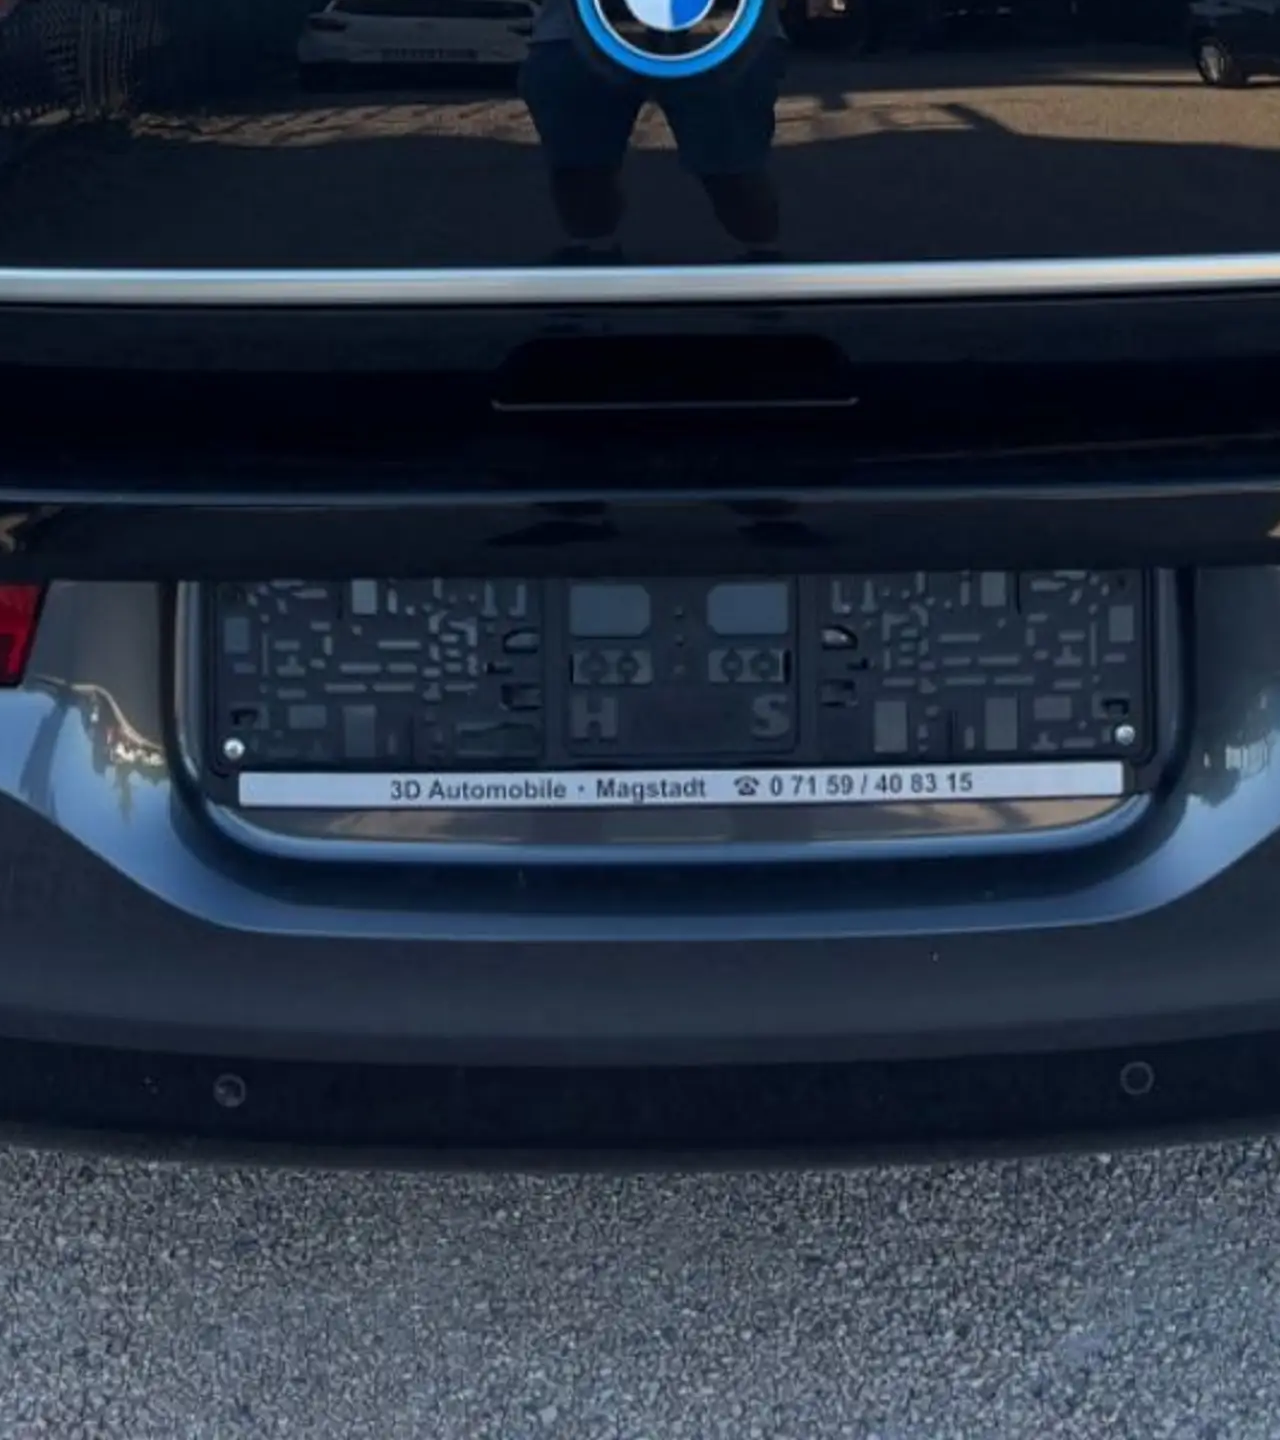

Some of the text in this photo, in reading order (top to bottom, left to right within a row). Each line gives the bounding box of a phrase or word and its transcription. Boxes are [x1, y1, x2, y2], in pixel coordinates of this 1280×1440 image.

[571, 695, 619, 739] H
[751, 693, 791, 738] S
[390, 777, 707, 803] 3D Automobile Magstadt
[769, 774, 784, 796] 0
[791, 774, 817, 796] 71
[825, 773, 854, 795] 59
[874, 772, 903, 794] 40
[910, 772, 937, 793] 83
[947, 771, 973, 792] 15
